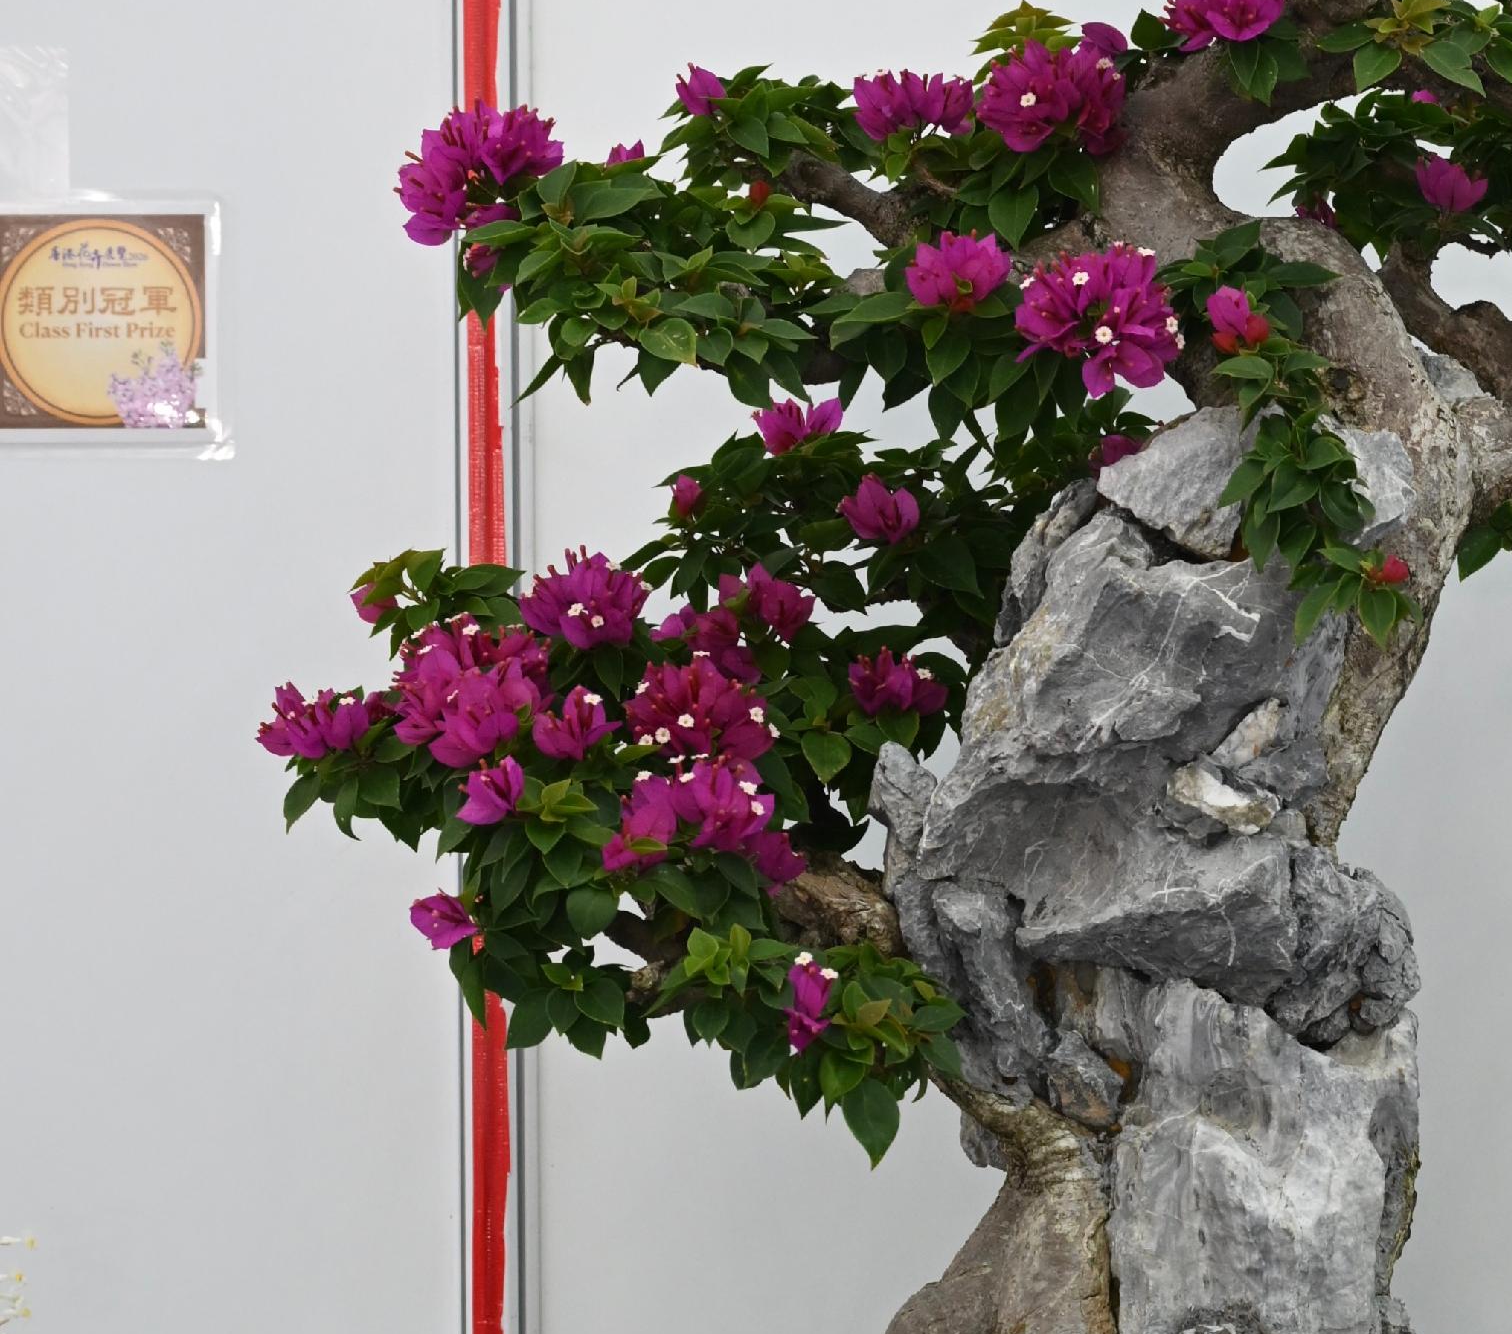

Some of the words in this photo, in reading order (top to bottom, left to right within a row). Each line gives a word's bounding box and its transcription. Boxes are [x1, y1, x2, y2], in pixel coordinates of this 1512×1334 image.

[18, 286, 177, 316] 類別冠軍
[19, 322, 70, 339] Class
[76, 322, 120, 338] First
[126, 322, 175, 338] Prize
